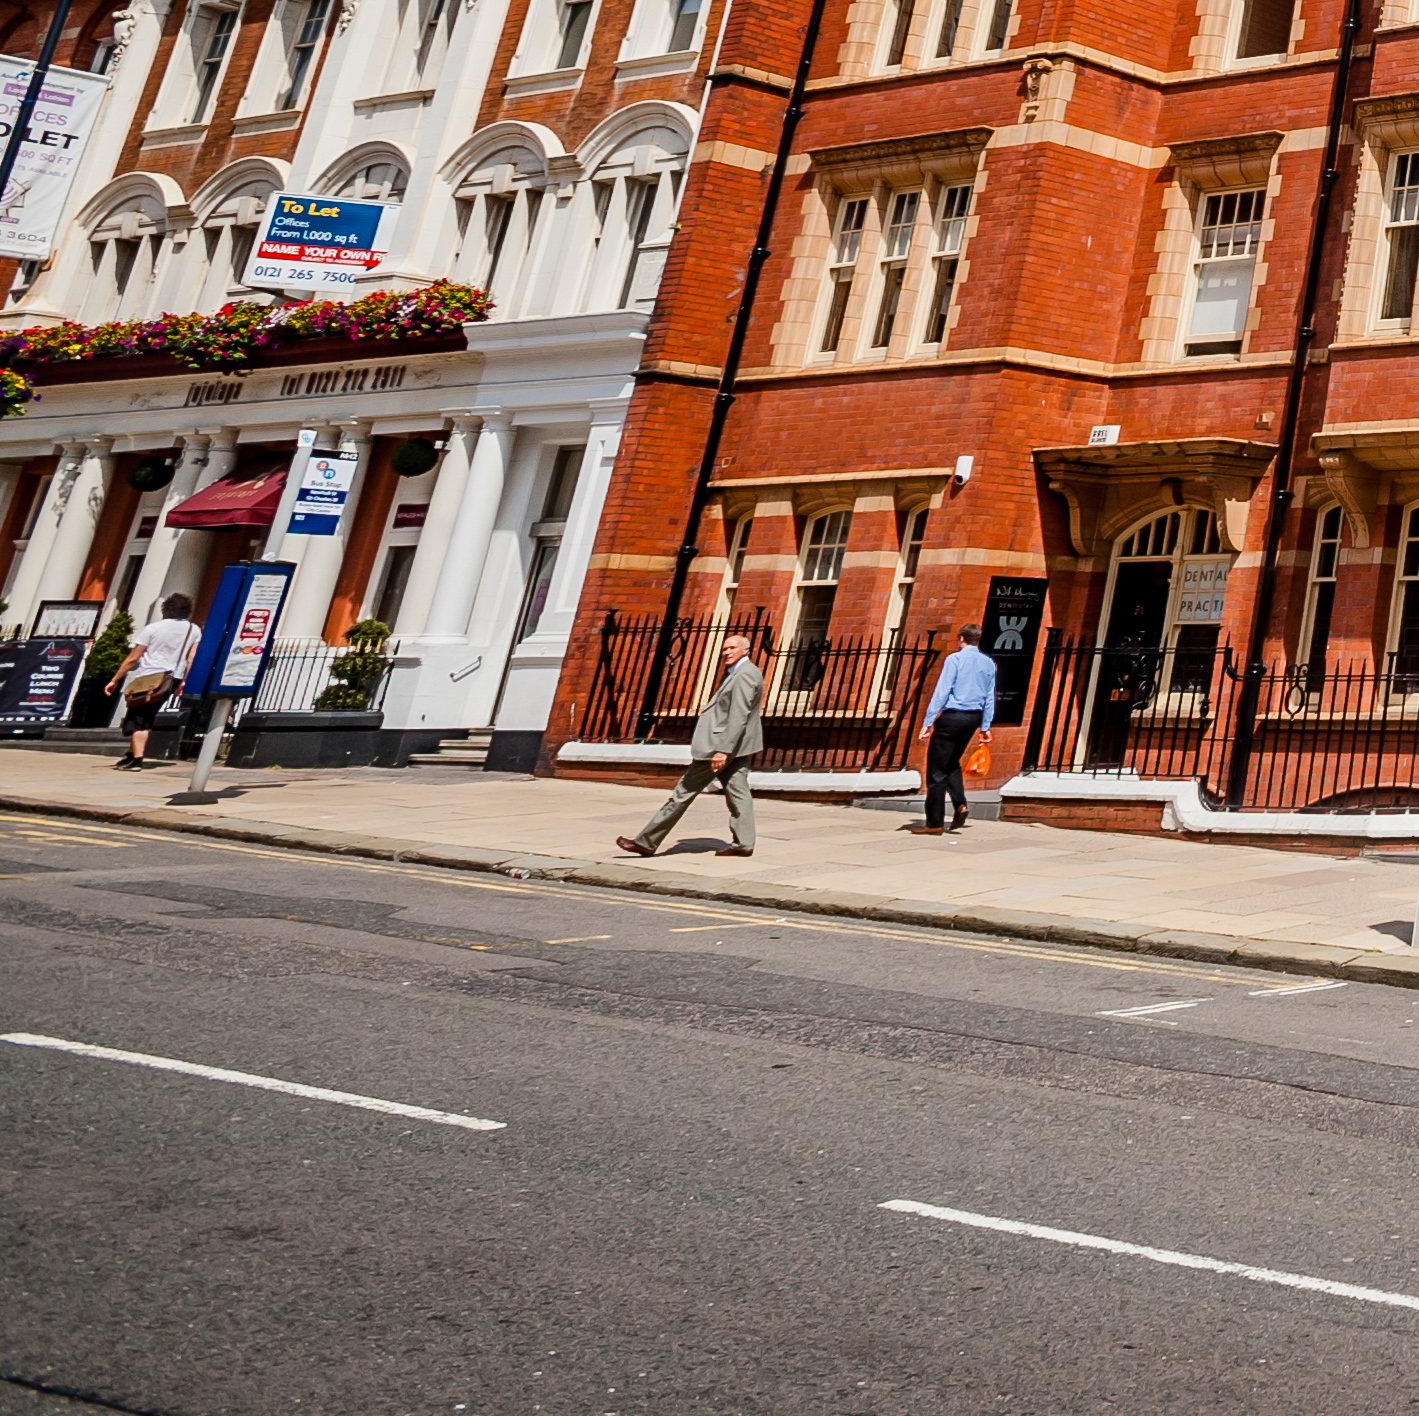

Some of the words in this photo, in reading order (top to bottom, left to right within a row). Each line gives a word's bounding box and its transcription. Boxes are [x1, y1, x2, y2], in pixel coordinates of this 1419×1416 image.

[0, 103, 68, 126] OFCES
[281, 200, 304, 214] To
[308, 203, 341, 218] Let
[275, 216, 310, 228] Offices
[270, 227, 300, 239] From
[334, 234, 346, 244] sq
[262, 243, 301, 255] NAME
[304, 247, 338, 258] YOUR
[340, 249, 370, 260] OWN
[254, 266, 282, 278] 0121
[287, 268, 315, 280] 265
[321, 271, 356, 283] 7500
[326, 480, 342, 488] Stop
[1185, 570, 1228, 582] DENTAL
[1179, 600, 1224, 613] PRACTI
